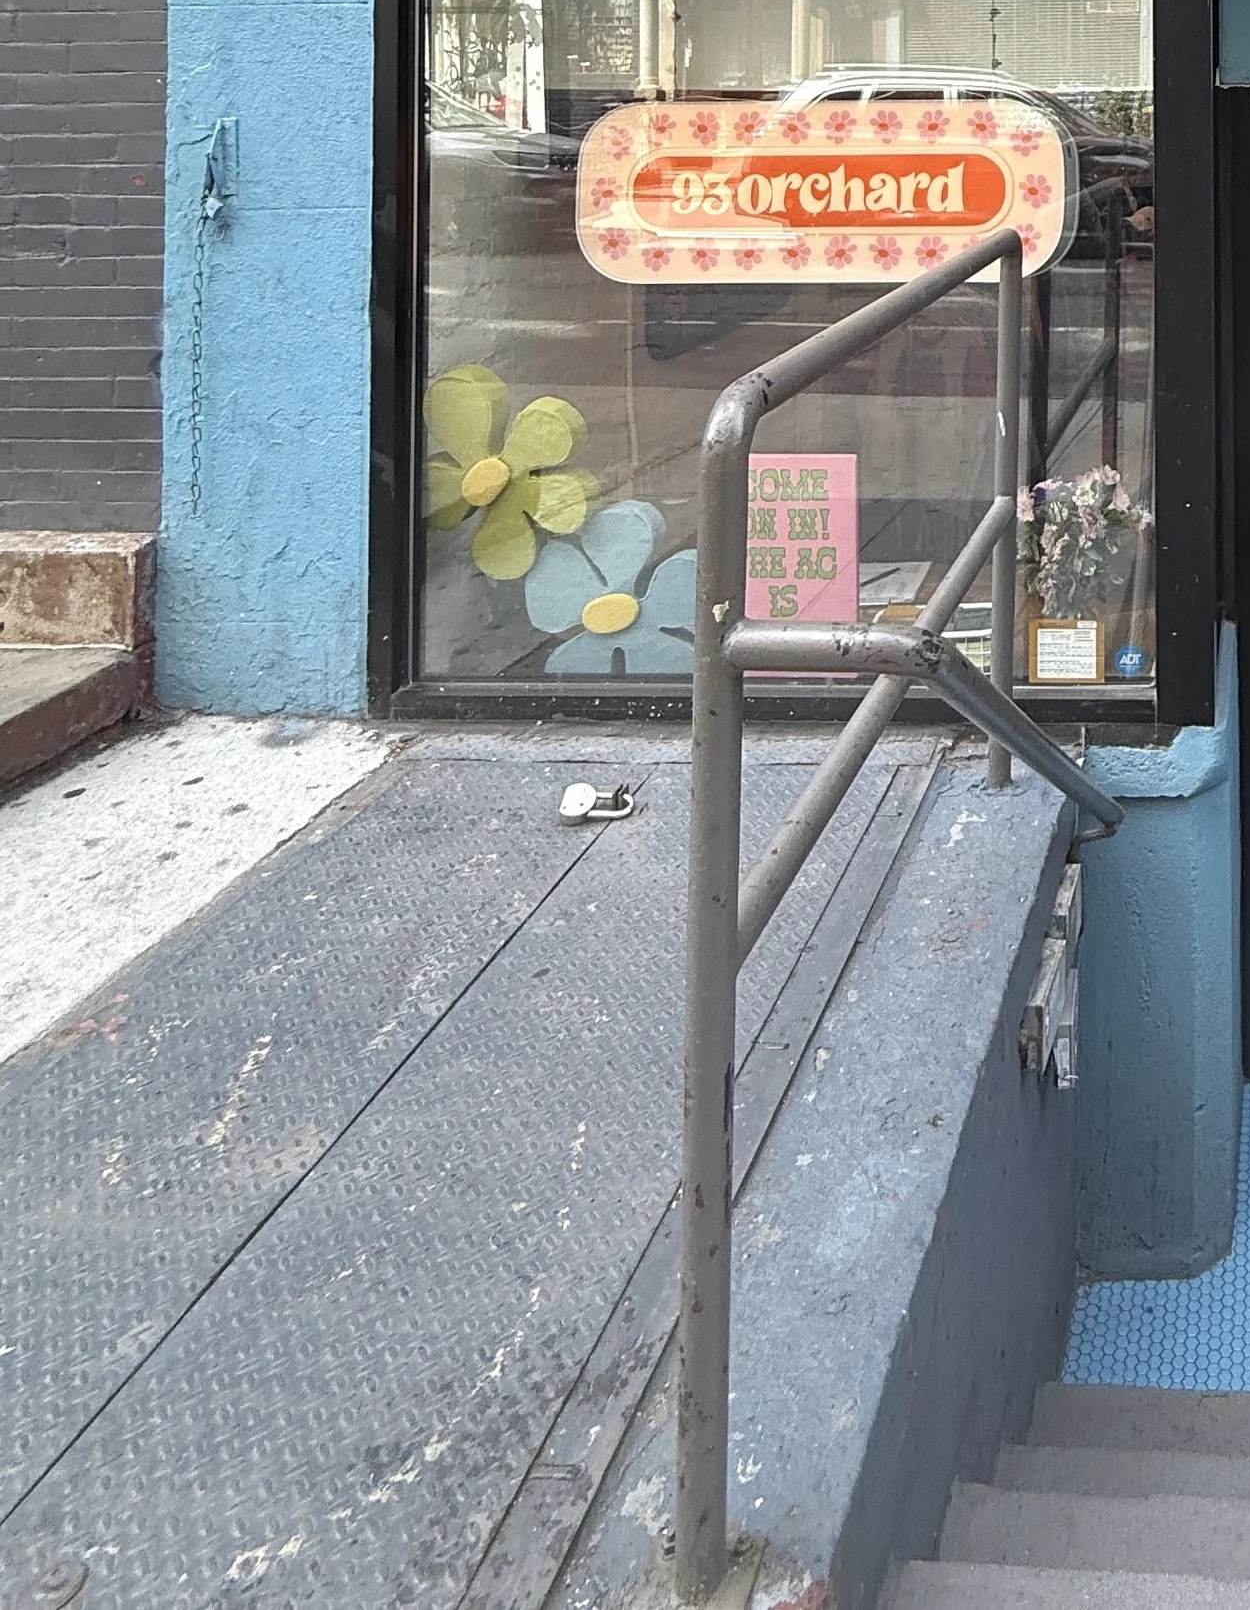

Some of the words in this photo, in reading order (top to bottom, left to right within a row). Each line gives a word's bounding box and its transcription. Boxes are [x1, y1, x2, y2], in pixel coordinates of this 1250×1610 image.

[787, 508, 831, 541] IN!
[794, 546, 838, 580] AC
[768, 584, 799, 618] IS
[1119, 653, 1142, 665] ADT
